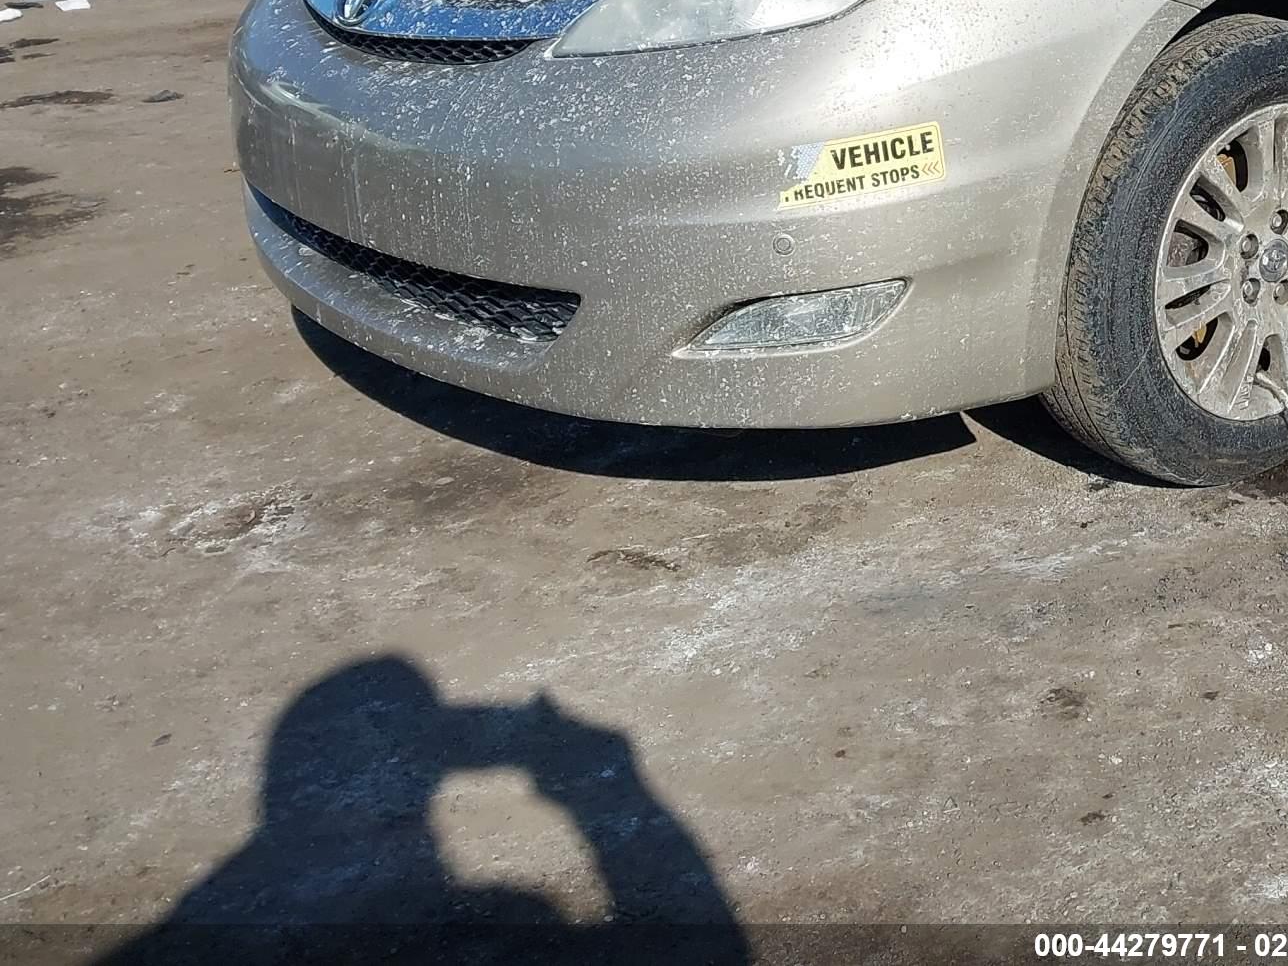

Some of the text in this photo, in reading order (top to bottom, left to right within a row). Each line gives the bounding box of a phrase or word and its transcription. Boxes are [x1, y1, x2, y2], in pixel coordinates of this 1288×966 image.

[829, 131, 934, 170] VEHICLE
[785, 164, 920, 203] REQUENT STOPS
